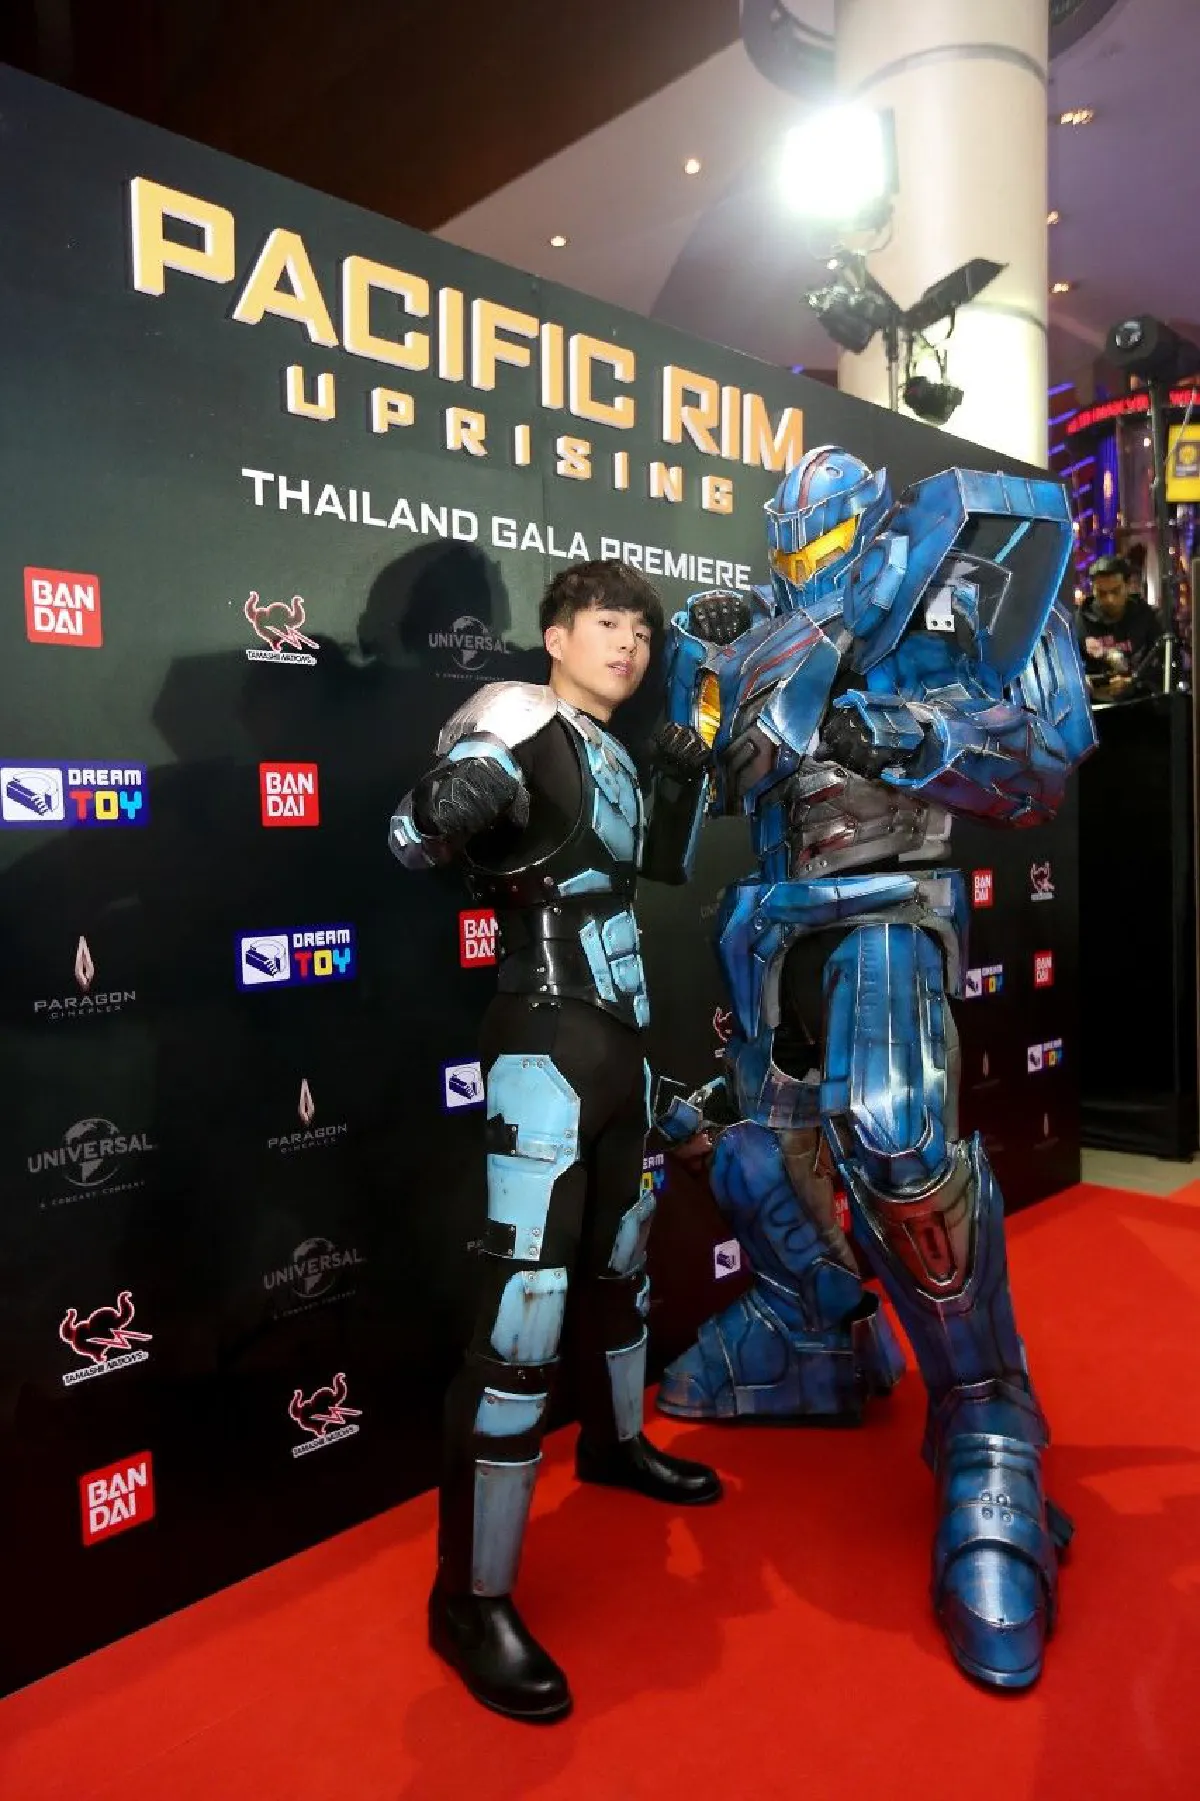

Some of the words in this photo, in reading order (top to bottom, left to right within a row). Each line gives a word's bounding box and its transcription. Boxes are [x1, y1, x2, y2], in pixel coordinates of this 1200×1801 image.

[130, 176, 636, 430] PACIFIC
[663, 365, 804, 474] RIM
[286, 364, 734, 516] UPRISING
[241, 467, 479, 543] THAILAND
[491, 515, 591, 562] GALA
[600, 536, 752, 591] PREMIERE
[31, 579, 95, 612] BAN
[34, 605, 84, 636] DAI
[428, 631, 510, 654] UNIVERSAL
[68, 769, 142, 786] DREAM
[265, 771, 315, 796] BAN
[69, 790, 143, 821] TOY
[267, 795, 305, 817] DAI
[292, 929, 351, 948] DREAM
[294, 947, 351, 978] TOY
[34, 991, 136, 1013] PARAGON
[51, 1005, 122, 1020] CINEPLEX
[267, 1122, 348, 1149] PARAGON
[28, 1132, 154, 1174] UNIVERSAL
[642, 1153, 665, 1170] EAM
[642, 1169, 665, 1191] OY
[263, 1248, 364, 1291] UNIVERSAL
[87, 1462, 148, 1508] BAN
[89, 1492, 137, 1535] DAI
